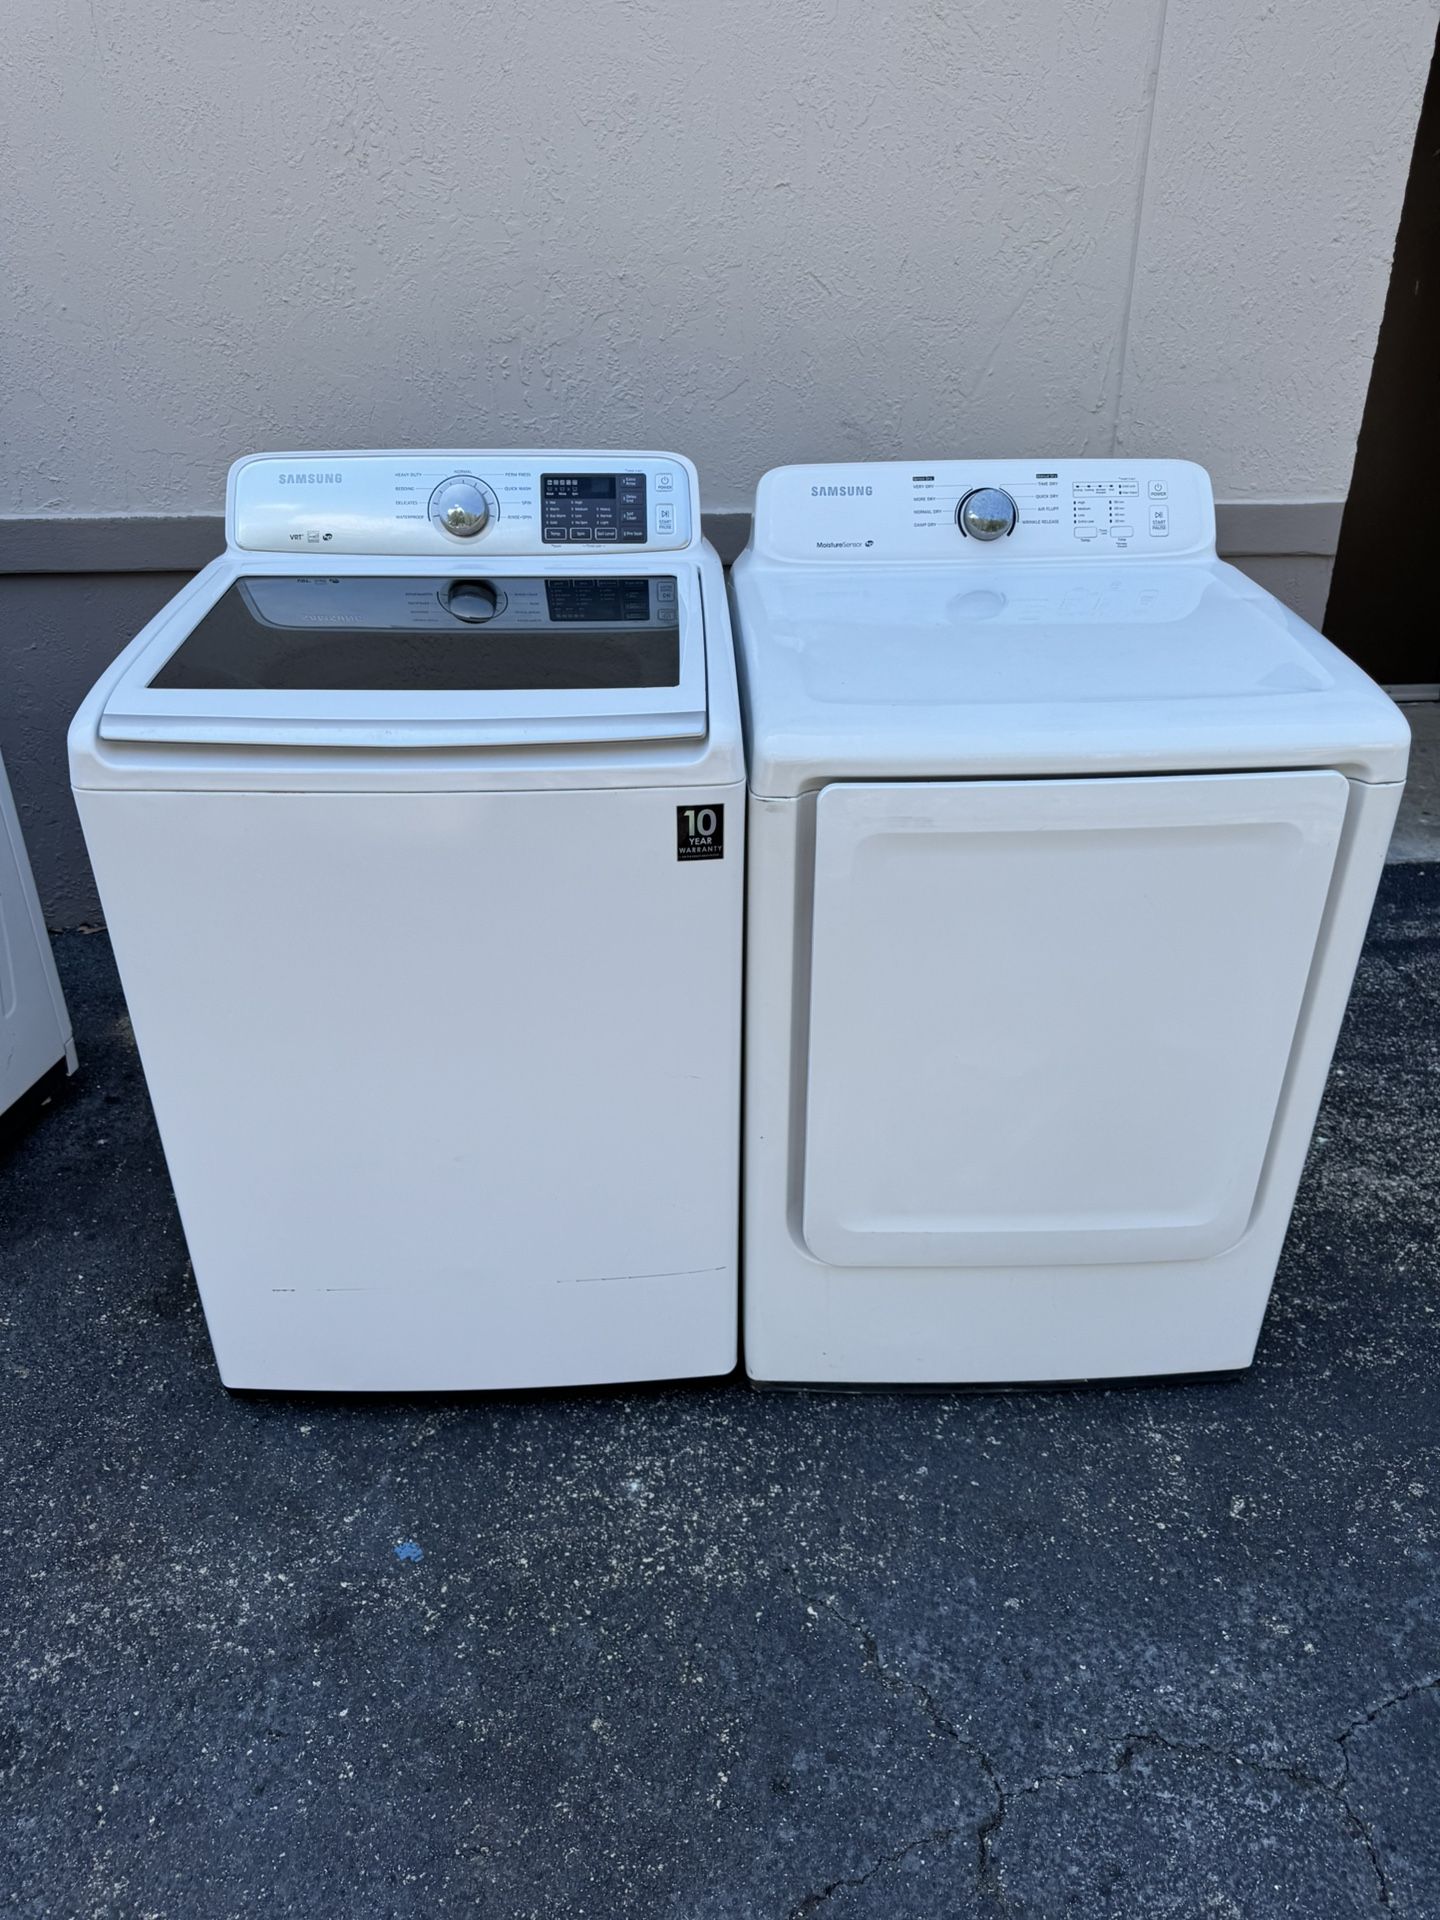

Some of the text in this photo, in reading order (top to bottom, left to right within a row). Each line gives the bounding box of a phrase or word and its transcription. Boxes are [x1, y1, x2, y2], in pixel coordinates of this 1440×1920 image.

[279, 473, 343, 484] SAMSUNG
[811, 486, 873, 496] SAMSUNG
[683, 809, 717, 836] 10
[689, 837, 712, 845] YEAR
[679, 846, 722, 854] WARRANTY
